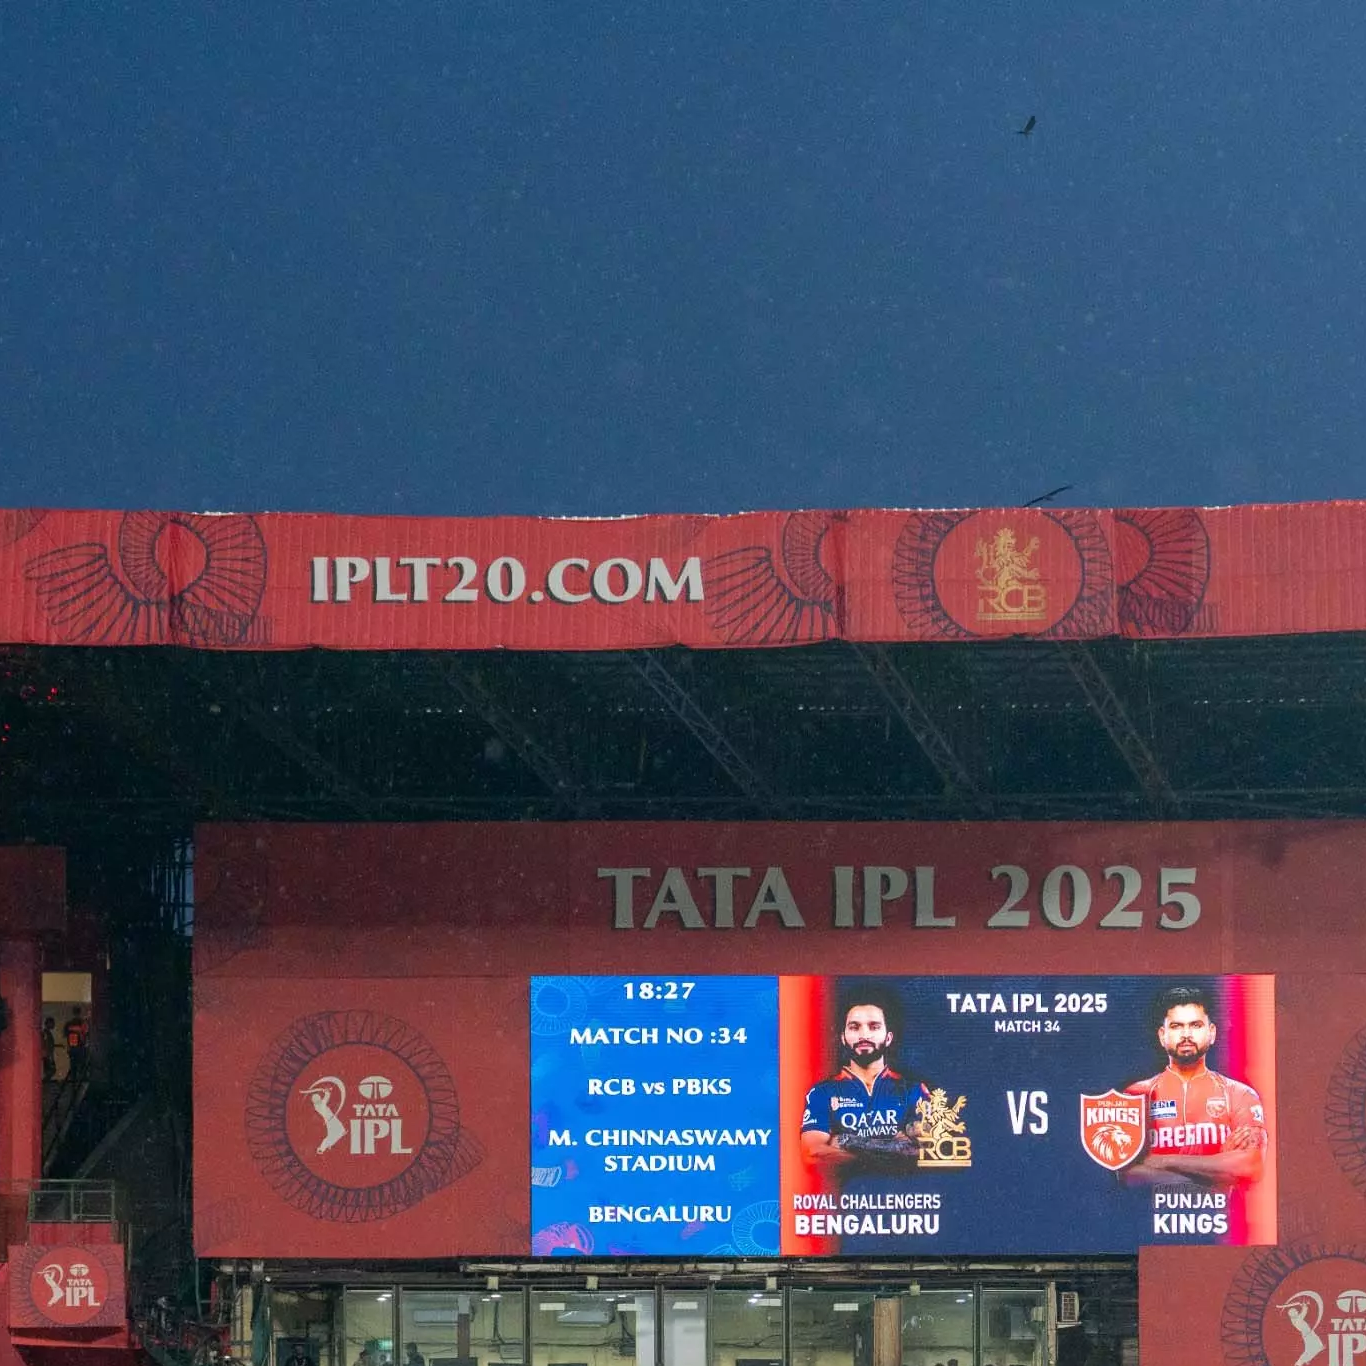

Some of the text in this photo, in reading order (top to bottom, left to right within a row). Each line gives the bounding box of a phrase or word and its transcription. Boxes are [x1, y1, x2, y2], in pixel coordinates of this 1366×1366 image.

[310, 554, 706, 605] IPLT20.COM
[976, 584, 1047, 613] RCB
[597, 864, 1202, 932] TATA IPL 2025
[623, 982, 696, 1000] 18:27
[947, 994, 1108, 1013] TATA IPL 2025
[569, 1028, 748, 1044] MATCH NO :34
[994, 1020, 1061, 1033] MATCH 34
[588, 1079, 732, 1095] RCB vs PBKS
[353, 1104, 399, 1116] TATA
[1006, 1090, 1049, 1135] VS
[1086, 1107, 1140, 1127] KINGS
[350, 1119, 413, 1154] IPL
[548, 1129, 772, 1146] M. CHINNASWAMY
[917, 1137, 972, 1160] RCB
[604, 1155, 716, 1172] STADIUM
[793, 1194, 941, 1210] ROYAL CHALLENGERS
[1154, 1194, 1226, 1209] PUNJAB
[588, 1206, 732, 1223] BENGALURU
[1153, 1213, 1228, 1235] KINGS
[795, 1214, 940, 1235] BENGALURU
[65, 1287, 100, 1307] IPL
